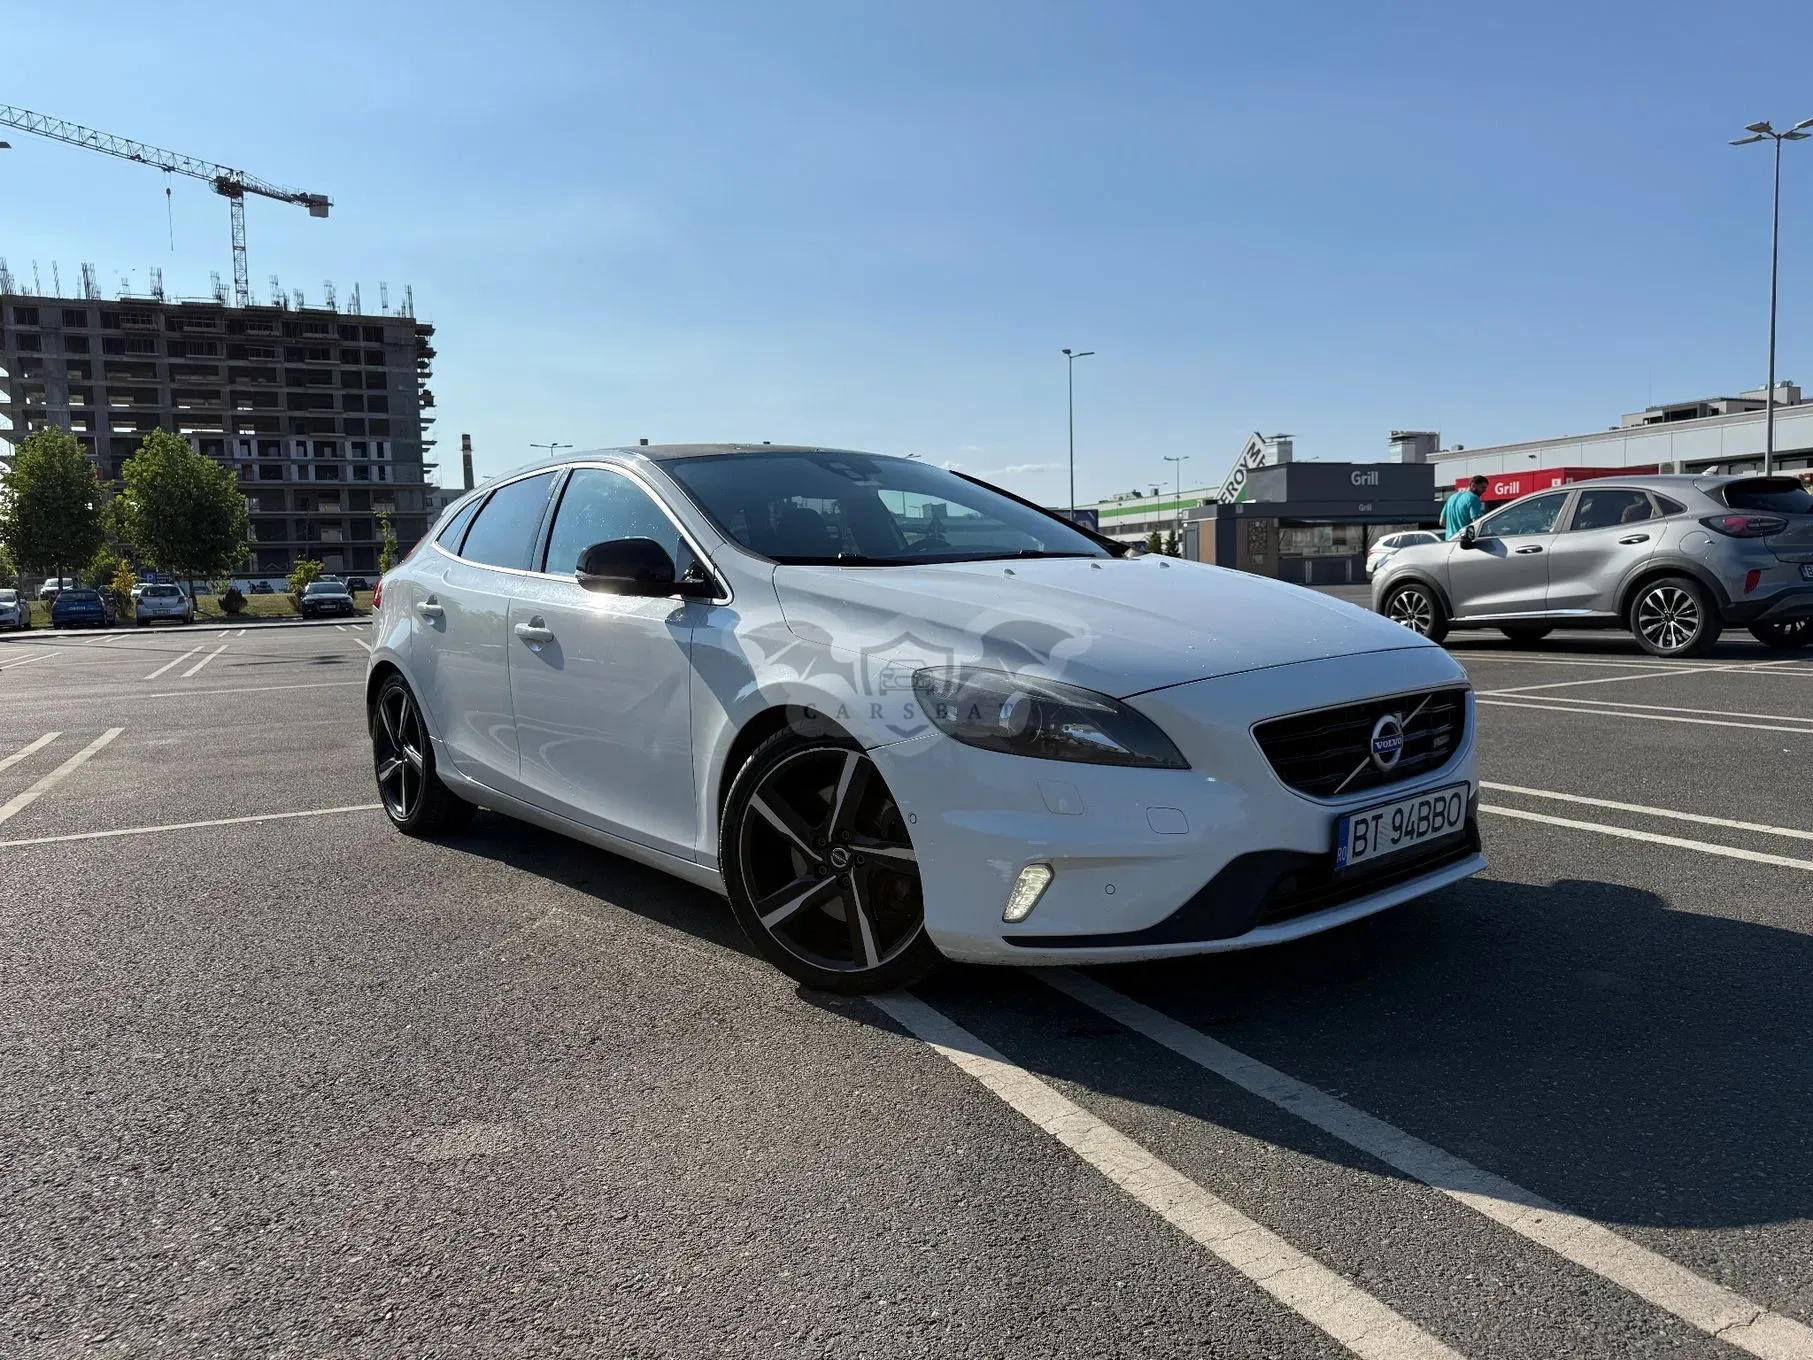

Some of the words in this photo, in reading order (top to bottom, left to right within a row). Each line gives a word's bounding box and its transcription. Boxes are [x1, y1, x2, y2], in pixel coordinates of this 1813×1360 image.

[1351, 470, 1379, 485] Grill
[1495, 481, 1520, 495] Grill
[1358, 503, 1373, 512] Grill
[1374, 737, 1402, 750] VOLVO
[1352, 813, 1384, 859] BT
[1336, 845, 1347, 864] RO
